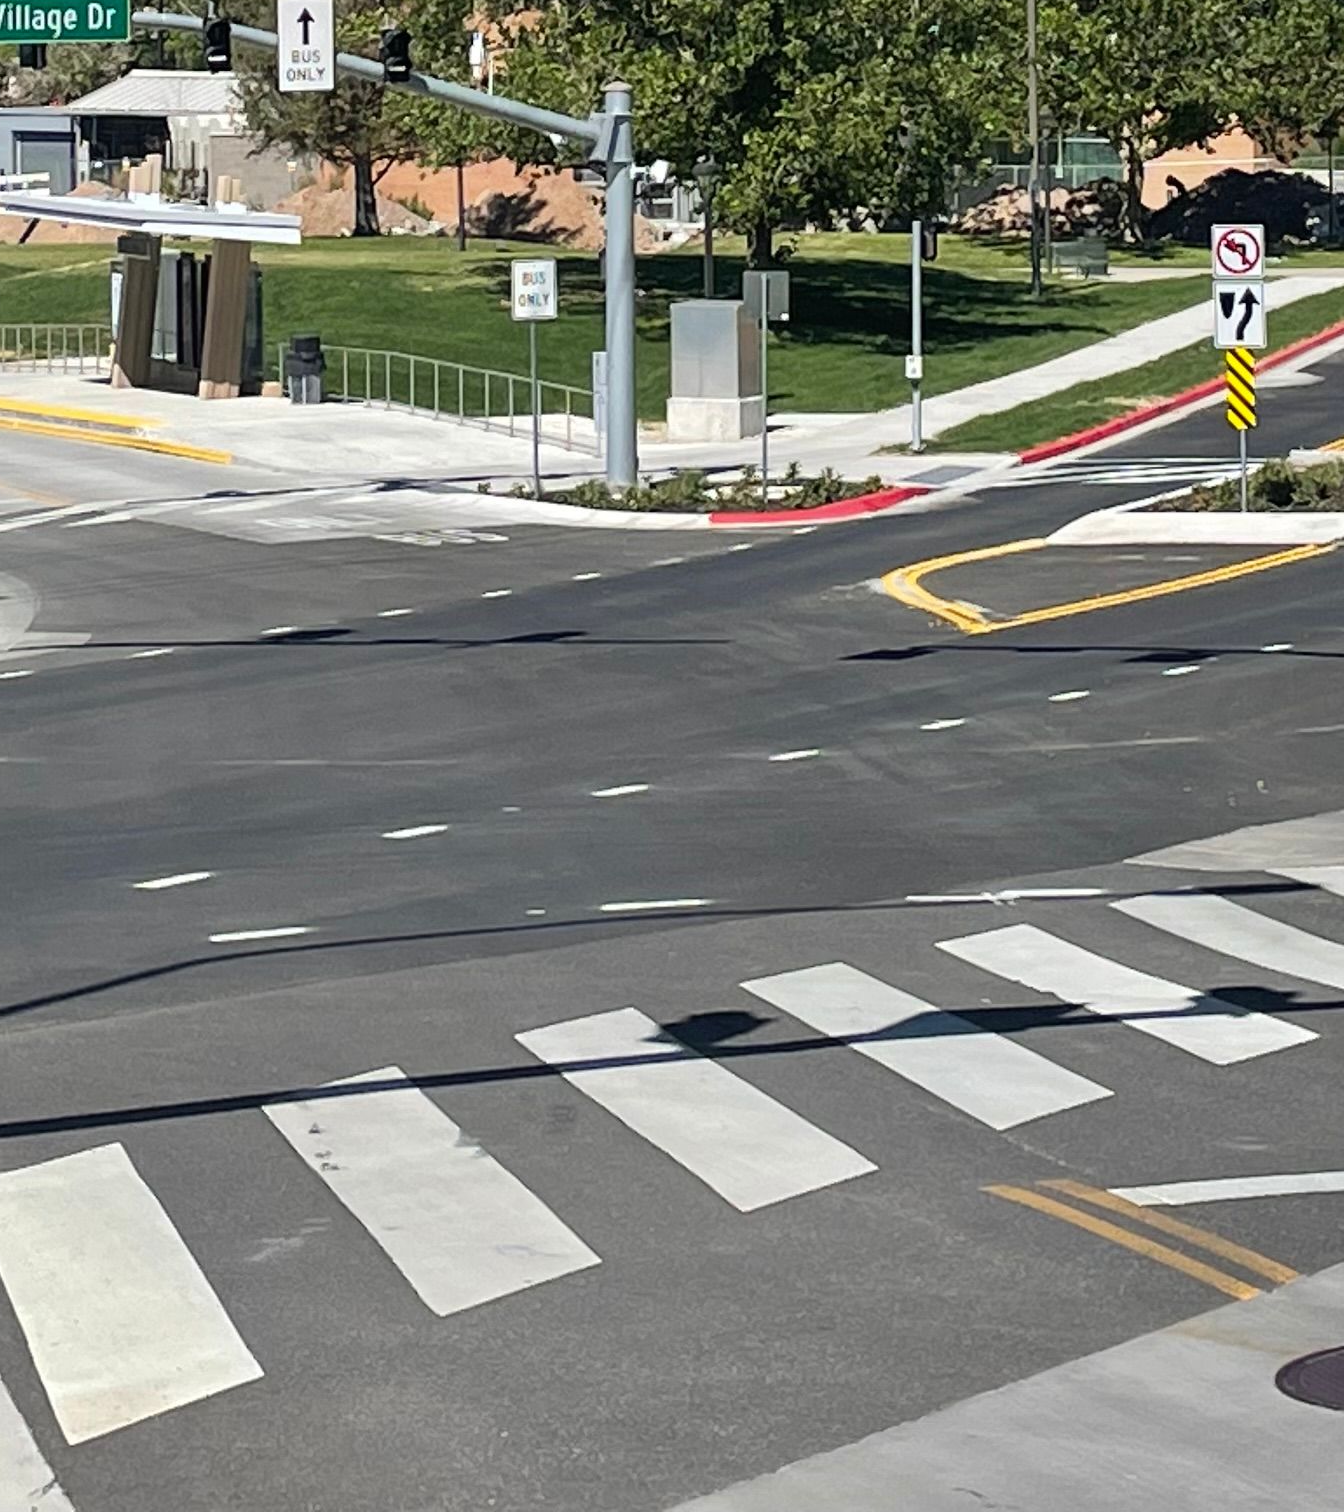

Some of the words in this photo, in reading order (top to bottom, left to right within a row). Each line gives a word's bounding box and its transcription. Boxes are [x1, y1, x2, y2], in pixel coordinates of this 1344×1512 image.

[87, 2, 117, 30] Dr
[291, 49, 321, 64] BUS
[286, 67, 326, 82] ONLY
[522, 271, 546, 286] BUS
[518, 292, 550, 307] ONLY
